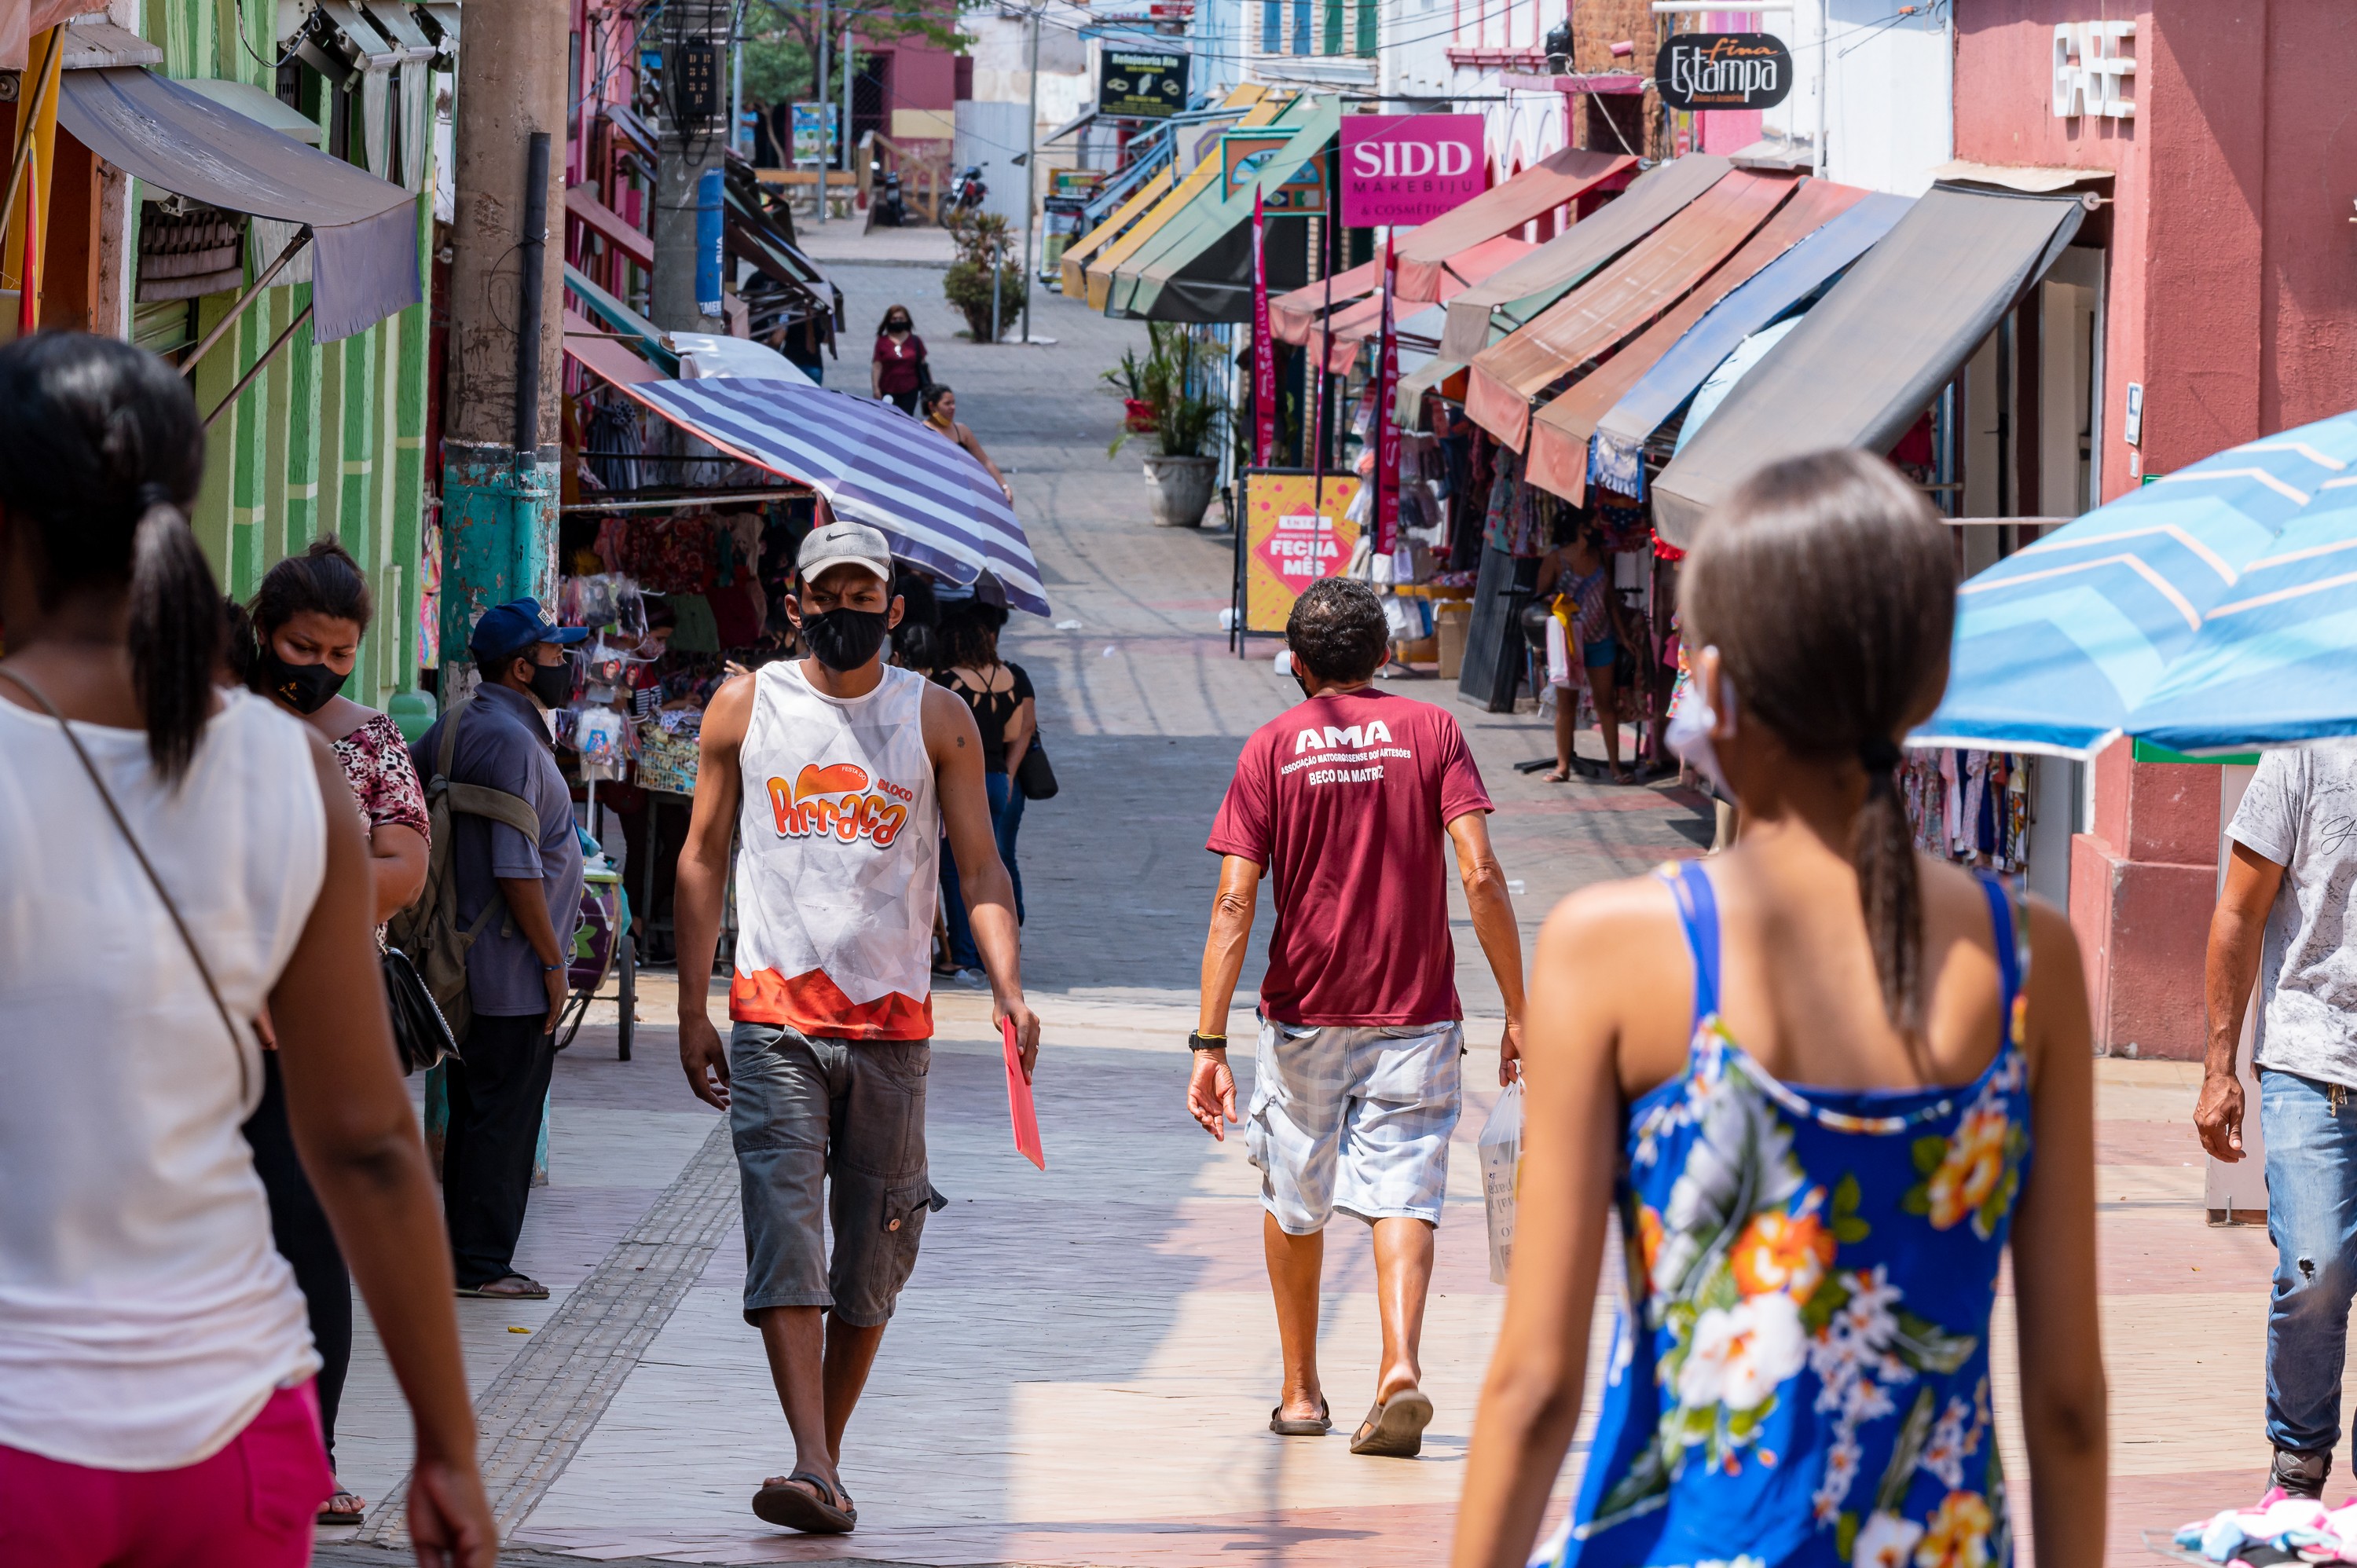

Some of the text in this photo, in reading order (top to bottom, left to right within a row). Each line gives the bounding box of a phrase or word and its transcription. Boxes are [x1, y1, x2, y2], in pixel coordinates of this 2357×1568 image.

[1701, 38, 1779, 67] fina
[1671, 46, 1777, 103] Estampa
[1353, 141, 1472, 178] SIDD
[1353, 180, 1473, 194] MAKEBIJU
[1270, 539, 1339, 558] FECHA
[1283, 556, 1326, 576] MÊS
[1295, 720, 1393, 755] AMA
[841, 766, 867, 781] FESTA DO
[1281, 755, 1317, 775] ASSOCIAÇÃO
[1317, 753, 1368, 764] MATOGROSSENSE
[1369, 749, 1380, 760] DOS
[1308, 765, 1384, 786] BECO DA MATRIZ
[877, 778, 913, 802] BLOCO
